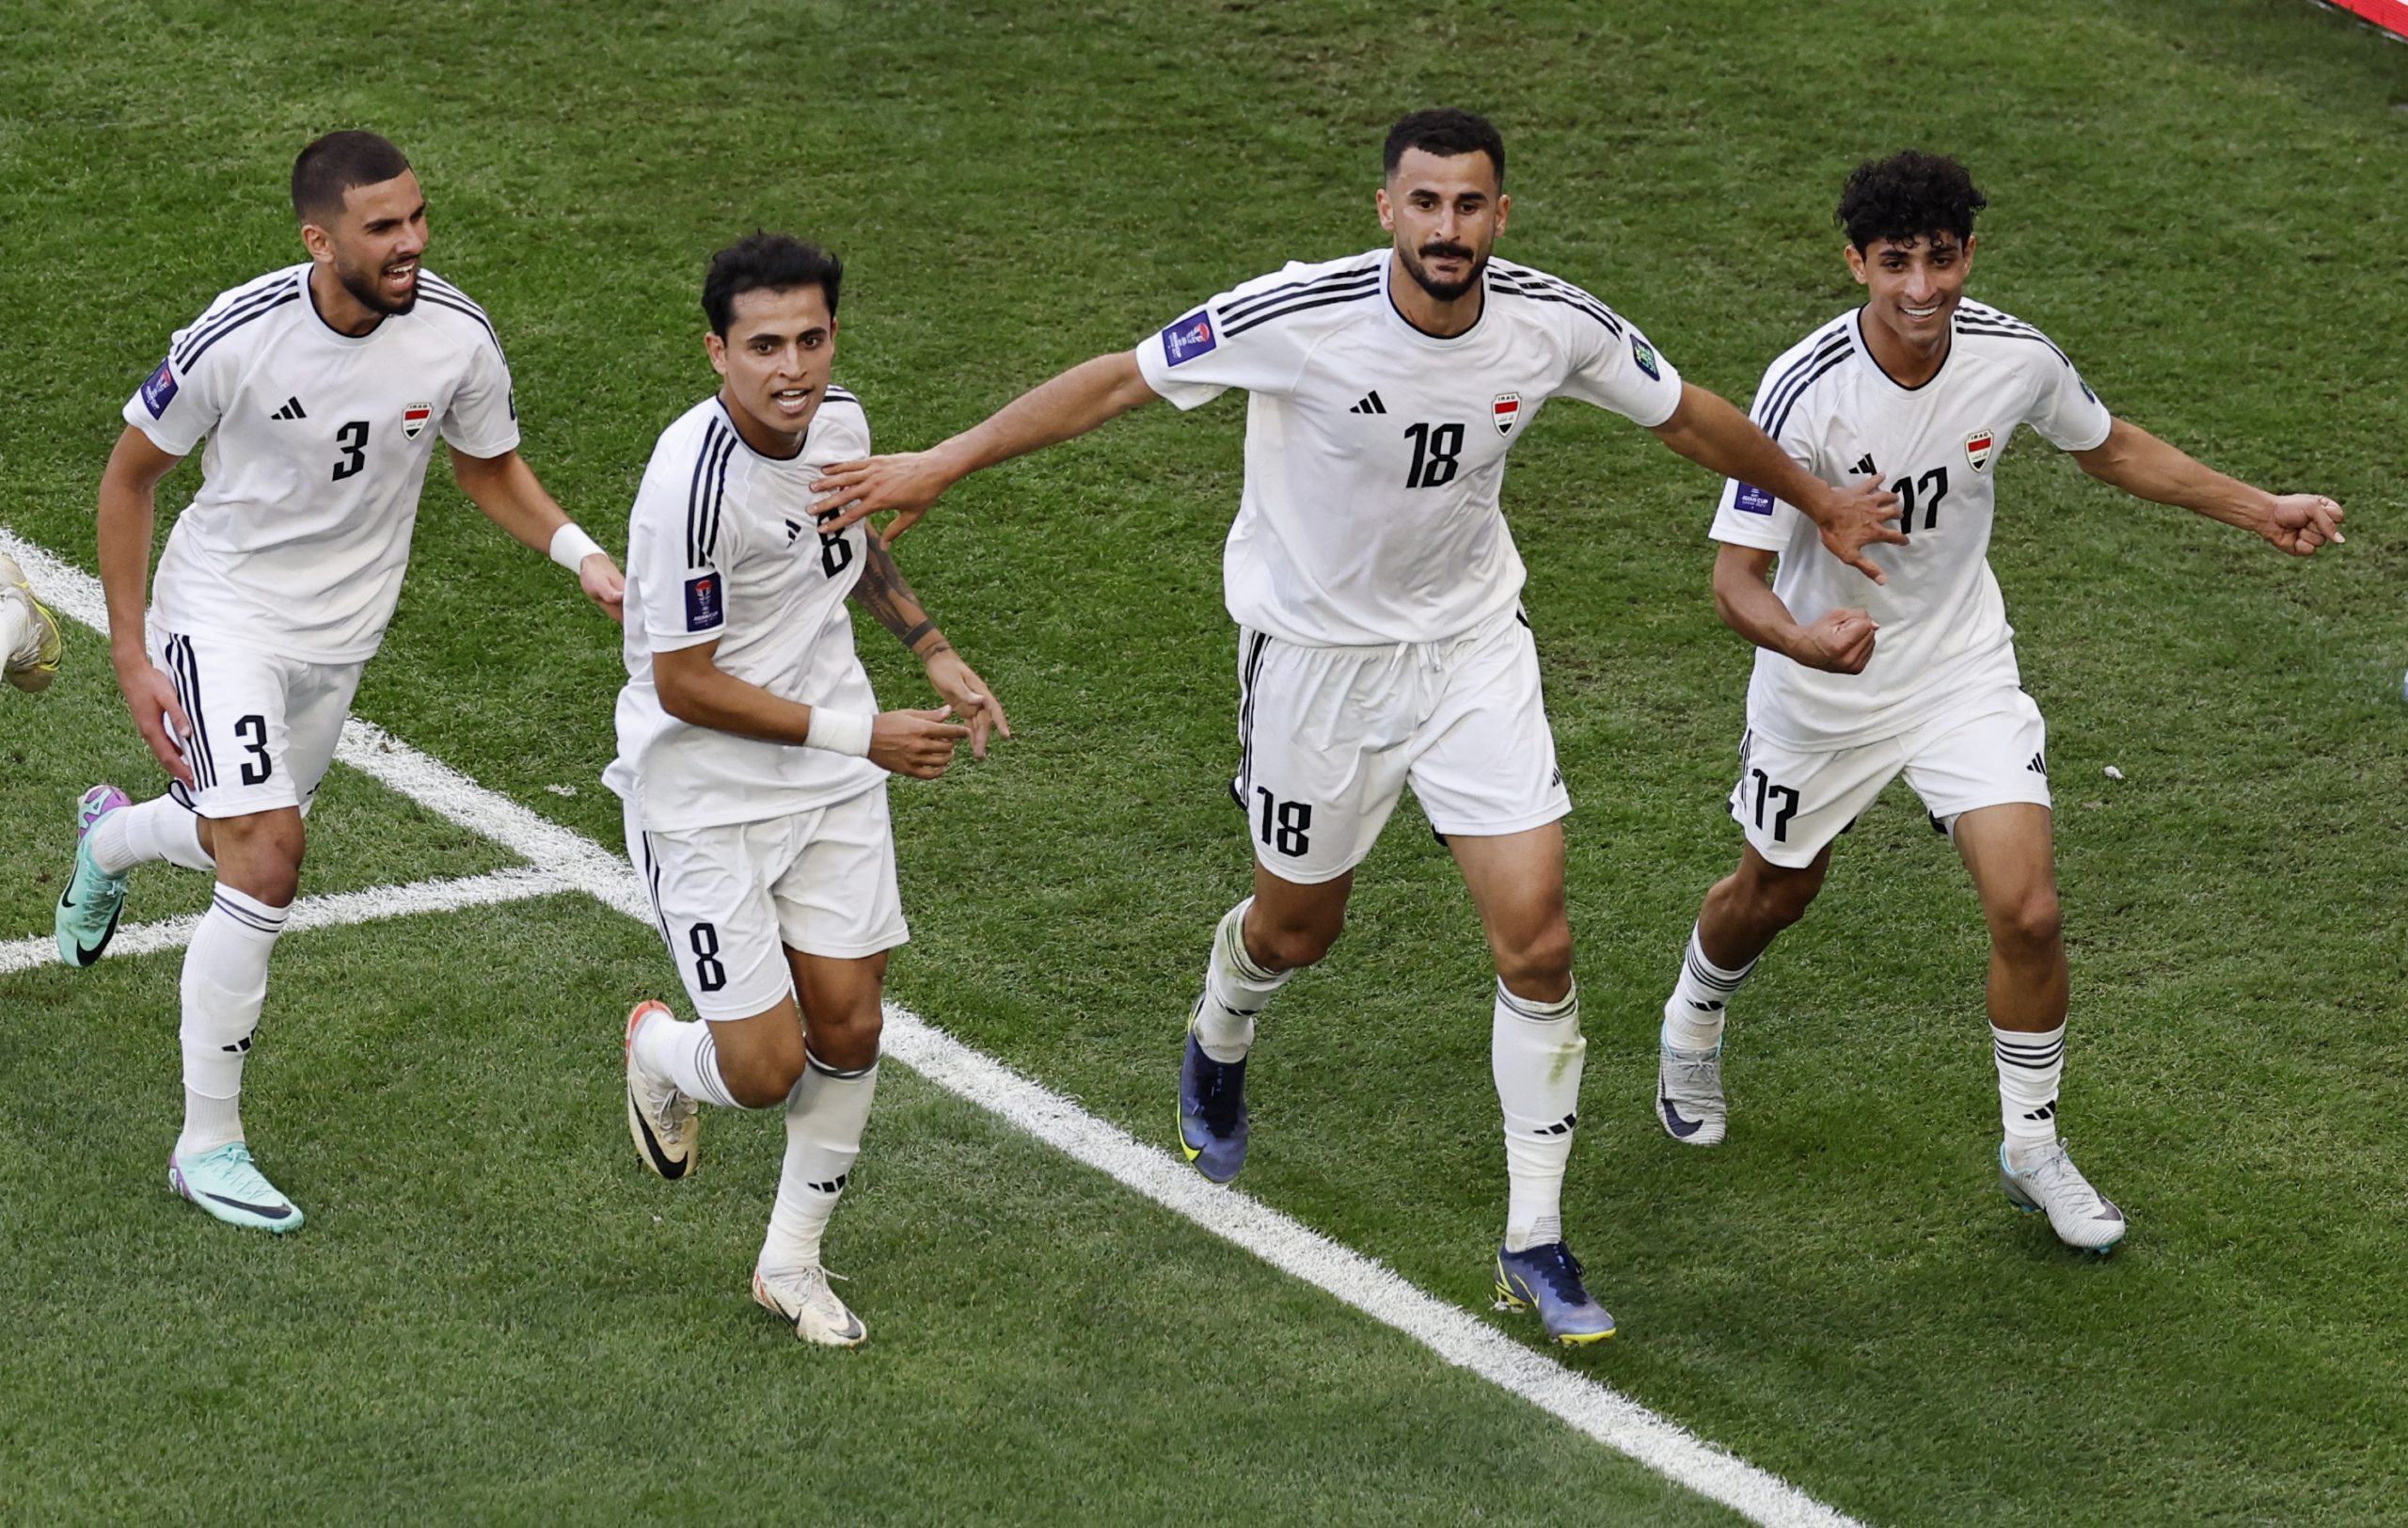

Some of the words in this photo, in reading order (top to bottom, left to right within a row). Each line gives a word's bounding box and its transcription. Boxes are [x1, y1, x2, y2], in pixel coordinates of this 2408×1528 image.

[332, 421, 370, 482] 3
[1404, 422, 1465, 489] 18
[1891, 466, 1948, 535] 17
[234, 714, 272, 787] 3
[1257, 786, 1312, 858] 18
[1752, 768, 1800, 843] 17
[689, 922, 727, 992] 8
